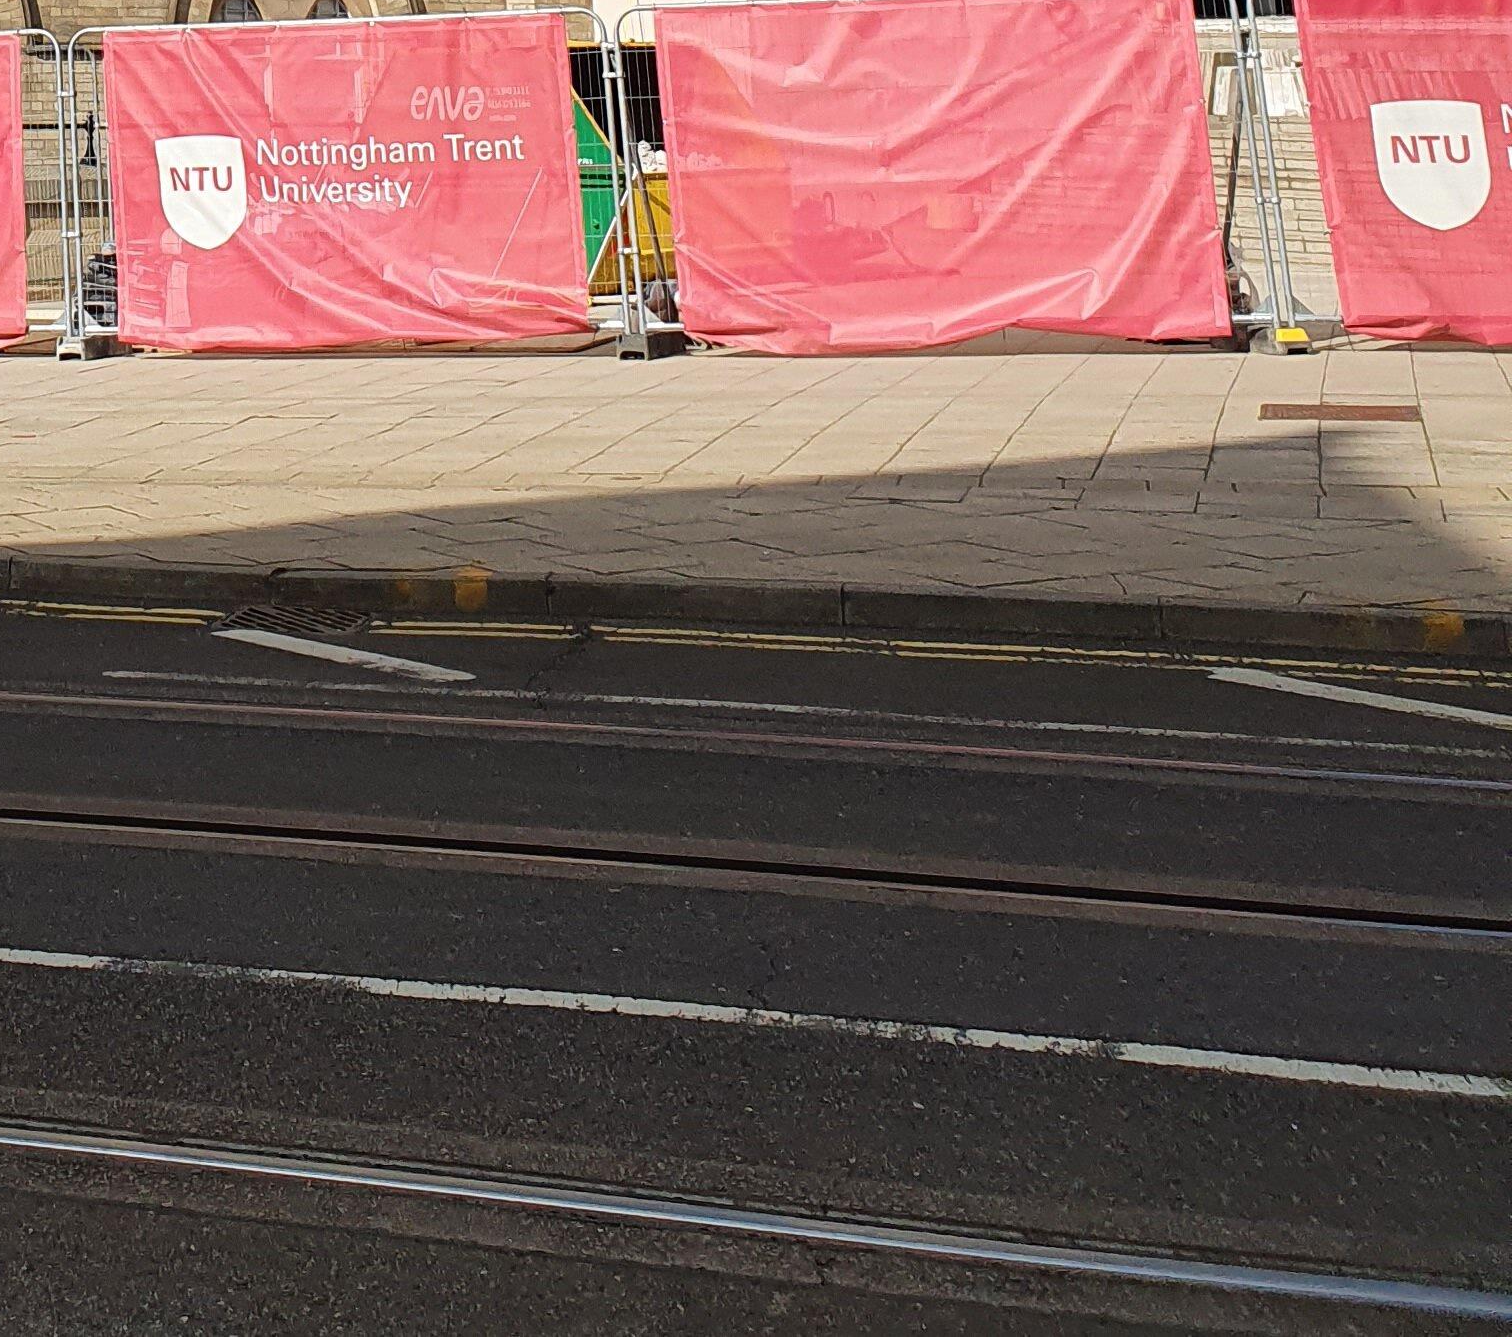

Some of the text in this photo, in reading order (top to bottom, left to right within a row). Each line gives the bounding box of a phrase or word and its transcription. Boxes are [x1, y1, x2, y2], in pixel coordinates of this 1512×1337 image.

[256, 133, 525, 170] Nottingham Trent
[1390, 135, 1471, 163] NTU
[169, 166, 233, 191] NTU
[259, 175, 413, 208] University
